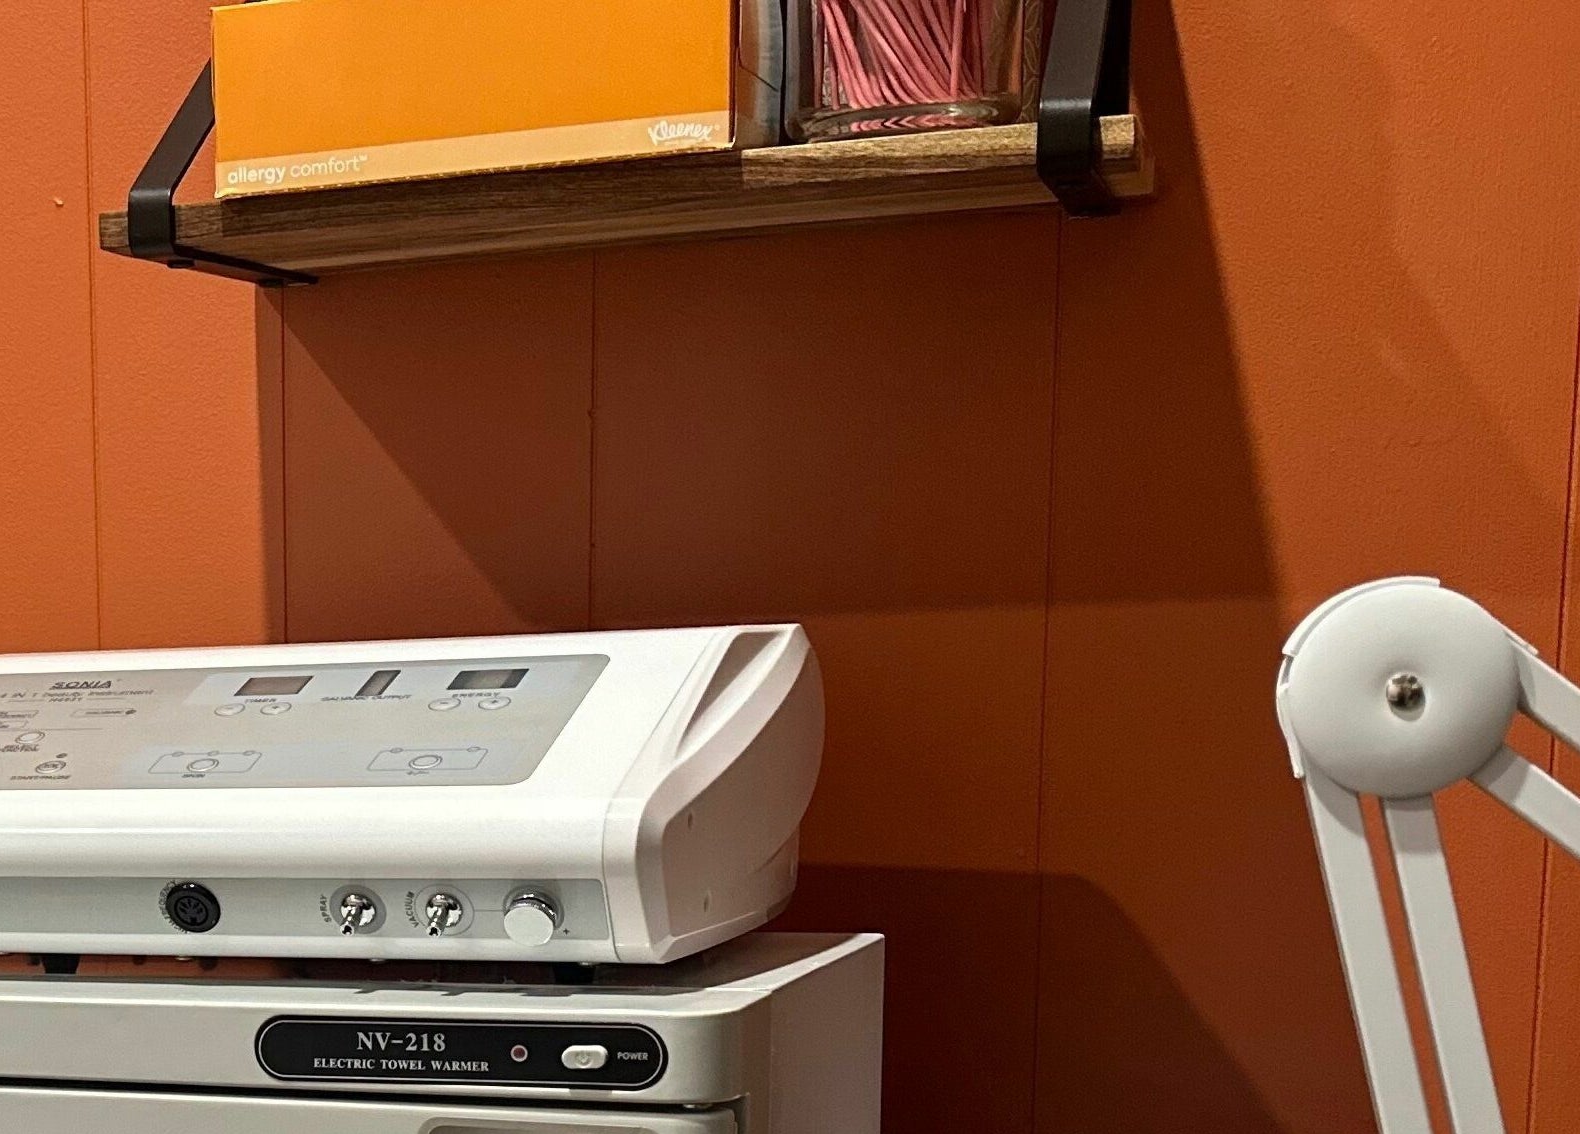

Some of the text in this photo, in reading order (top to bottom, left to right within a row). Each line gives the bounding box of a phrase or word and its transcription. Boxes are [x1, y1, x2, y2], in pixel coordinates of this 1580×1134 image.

[648, 120, 714, 146] Kleenex
[227, 164, 286, 184] allergy
[50, 680, 112, 690] SONIA
[319, 893, 332, 923] SPRAY
[404, 890, 420, 928] VACUUM
[356, 1031, 447, 1053] NV-218
[313, 1057, 490, 1073] ELECTRIC TOWEL WARMER
[617, 1051, 649, 1061] POWER
